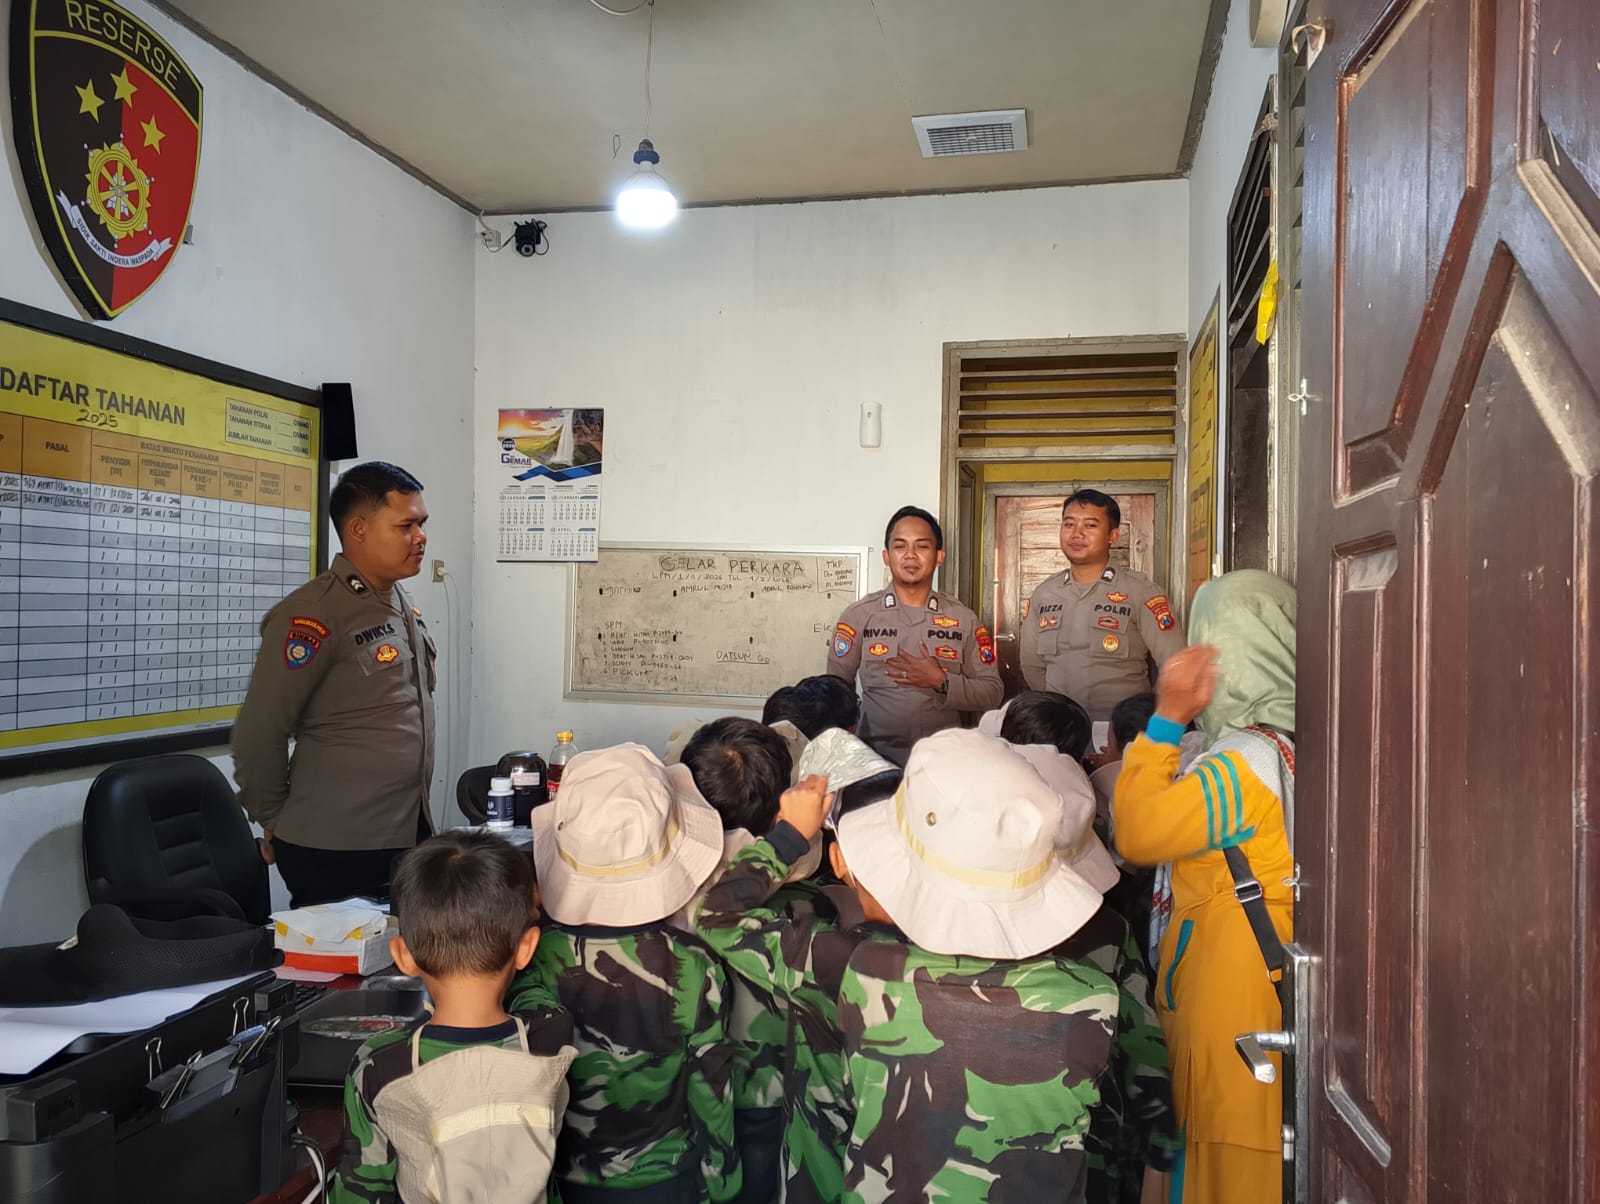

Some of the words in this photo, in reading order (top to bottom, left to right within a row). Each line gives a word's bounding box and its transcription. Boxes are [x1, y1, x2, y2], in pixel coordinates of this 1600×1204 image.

[66, 1, 181, 91] RESERSE
[76, 217, 90, 241] SIDIK
[90, 238, 107, 257] SAKTI
[0, 367, 91, 407] DAFTAR
[96, 388, 186, 426] TAHANAN
[76, 409, 119, 428] 2025
[45, 441, 71, 453] PASAL
[660, 556, 717, 572] GELAR
[729, 559, 804, 577] PERKARA
[826, 560, 843, 569] TKP
[1039, 604, 1064, 615] RIZZA
[1094, 604, 1132, 617] POLRI
[863, 628, 898, 639] RIVAN
[927, 629, 963, 641] POLRI
